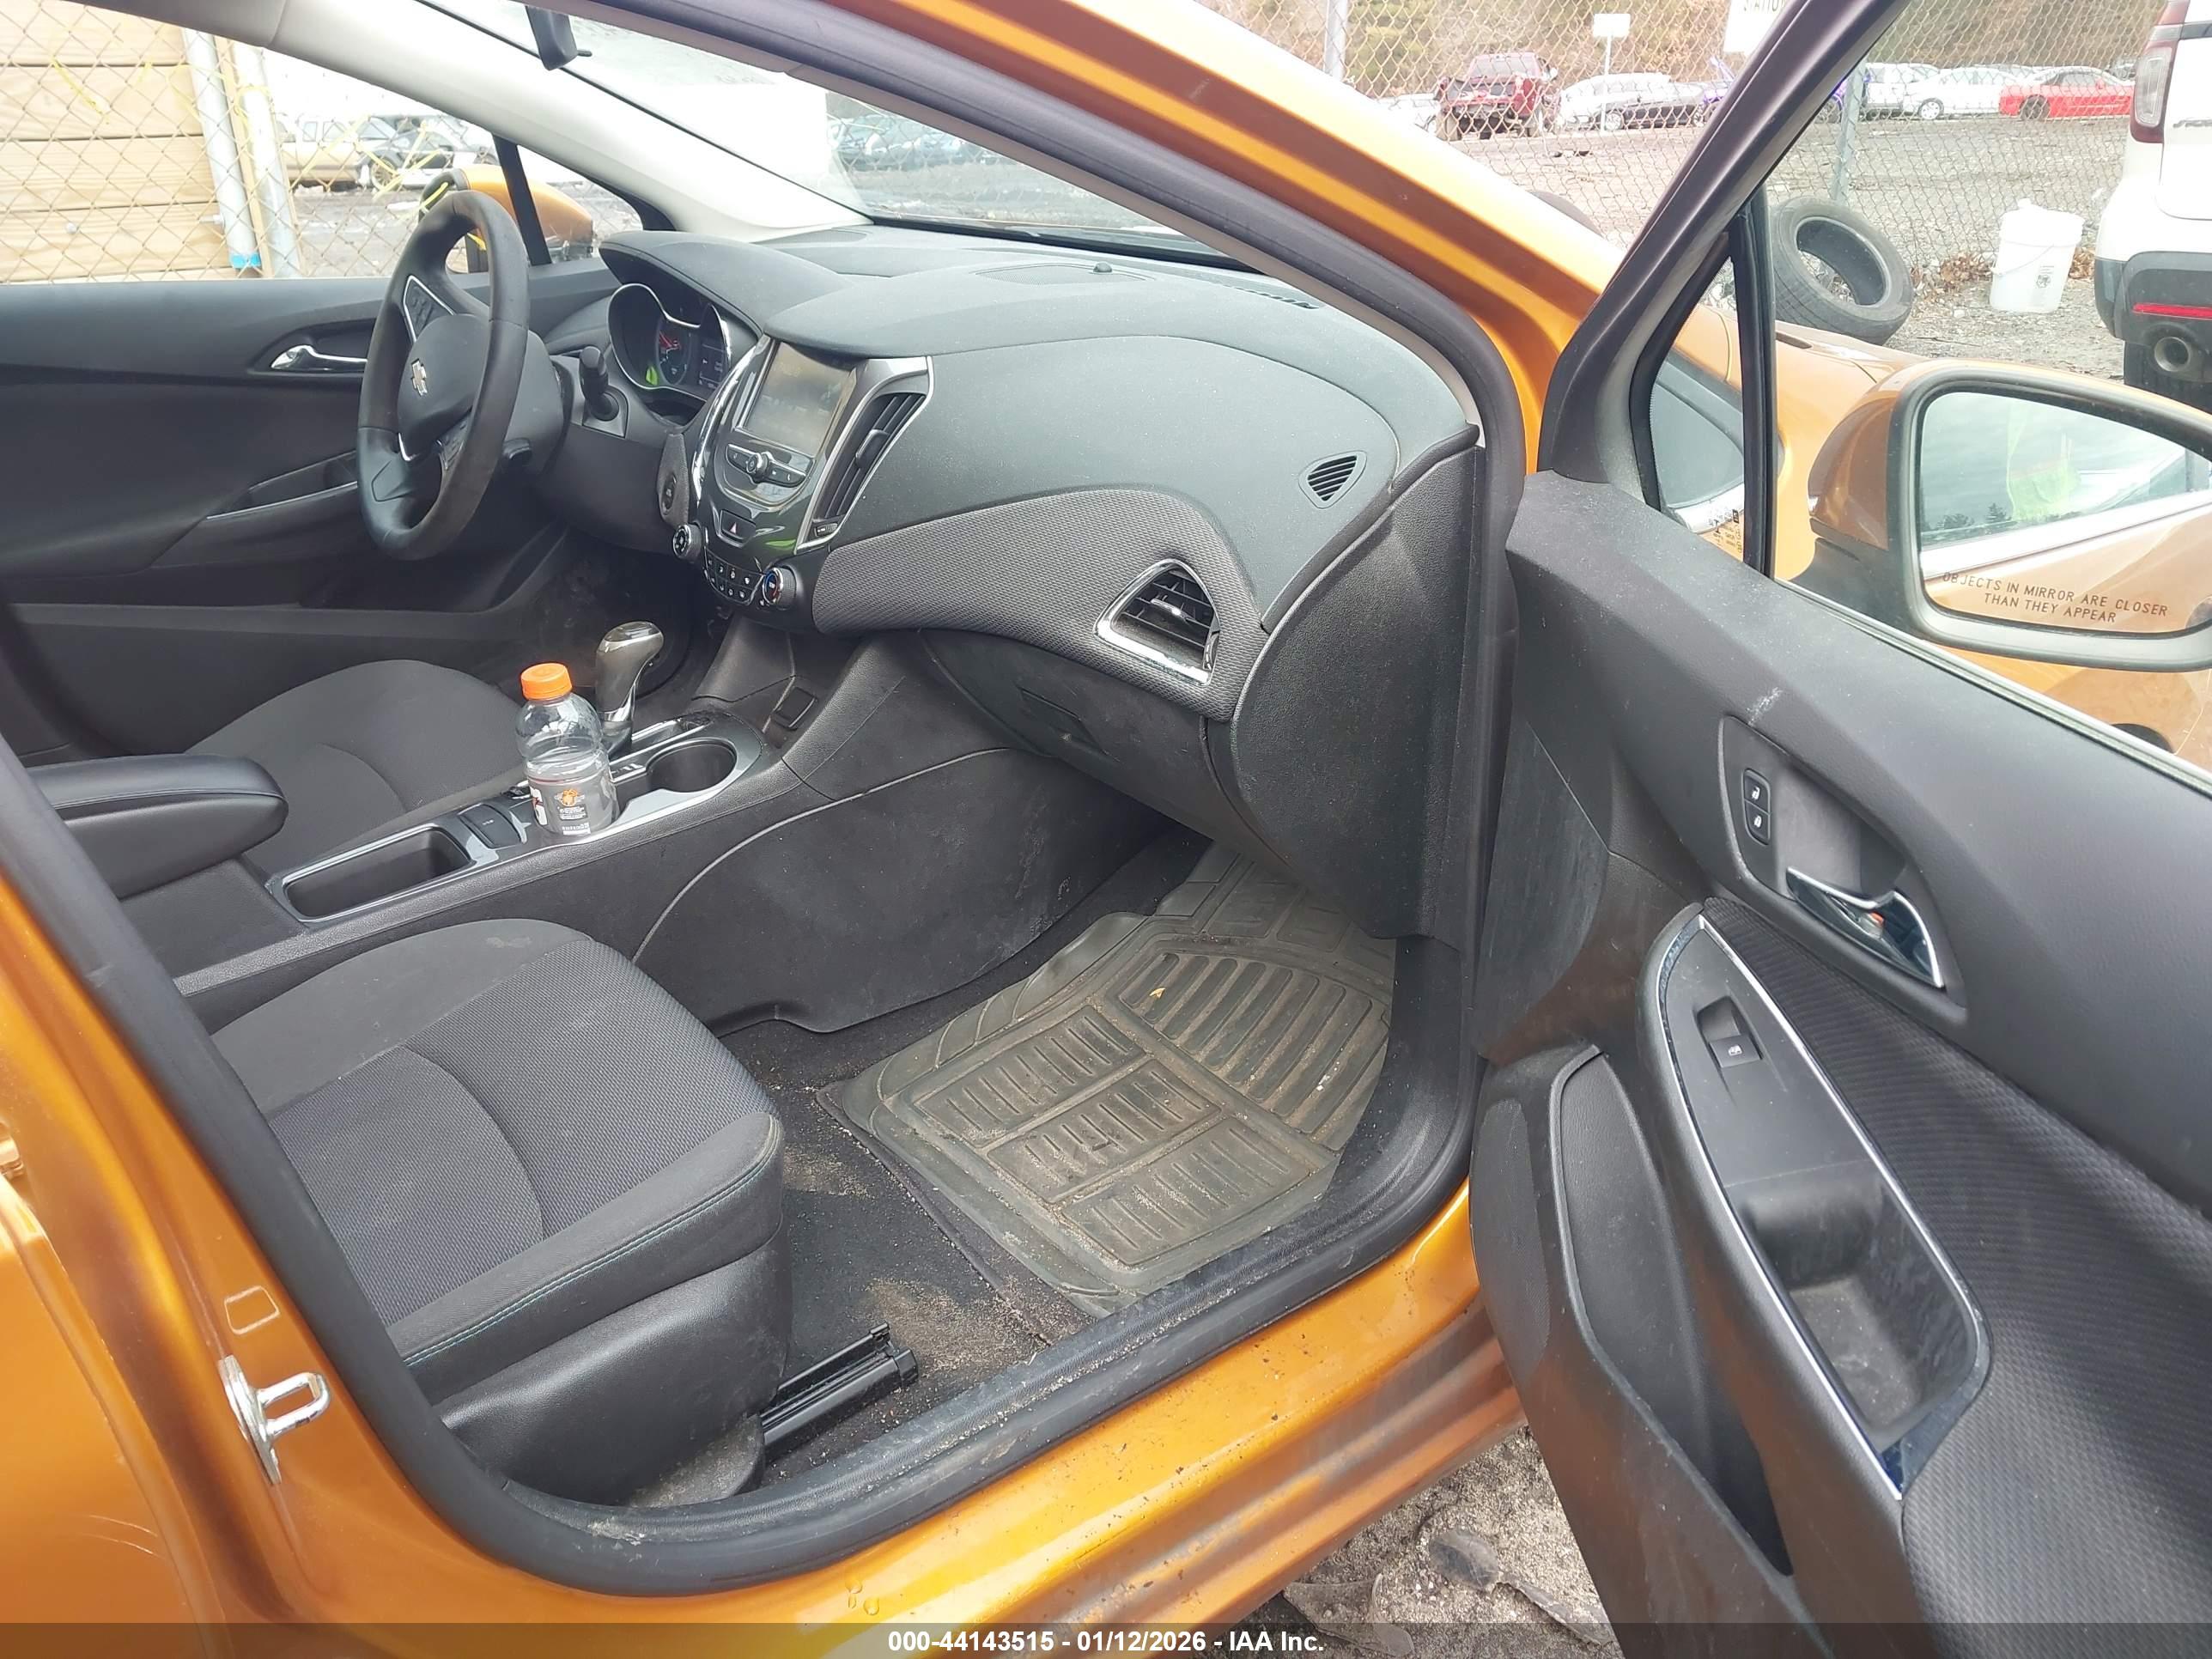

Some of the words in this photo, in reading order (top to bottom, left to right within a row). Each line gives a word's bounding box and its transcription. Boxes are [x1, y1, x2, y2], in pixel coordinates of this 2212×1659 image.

[1942, 572, 2002, 592] OBJECTS
[2006, 582, 2020, 594] IN
[2023, 584, 2075, 602] MIRROR
[2081, 593, 2109, 607] ARE
[2115, 599, 2169, 617] CLOSER
[1984, 592, 2020, 608] THAN
[2025, 599, 2059, 614] THEY
[2063, 605, 2117, 623] APPEAR
